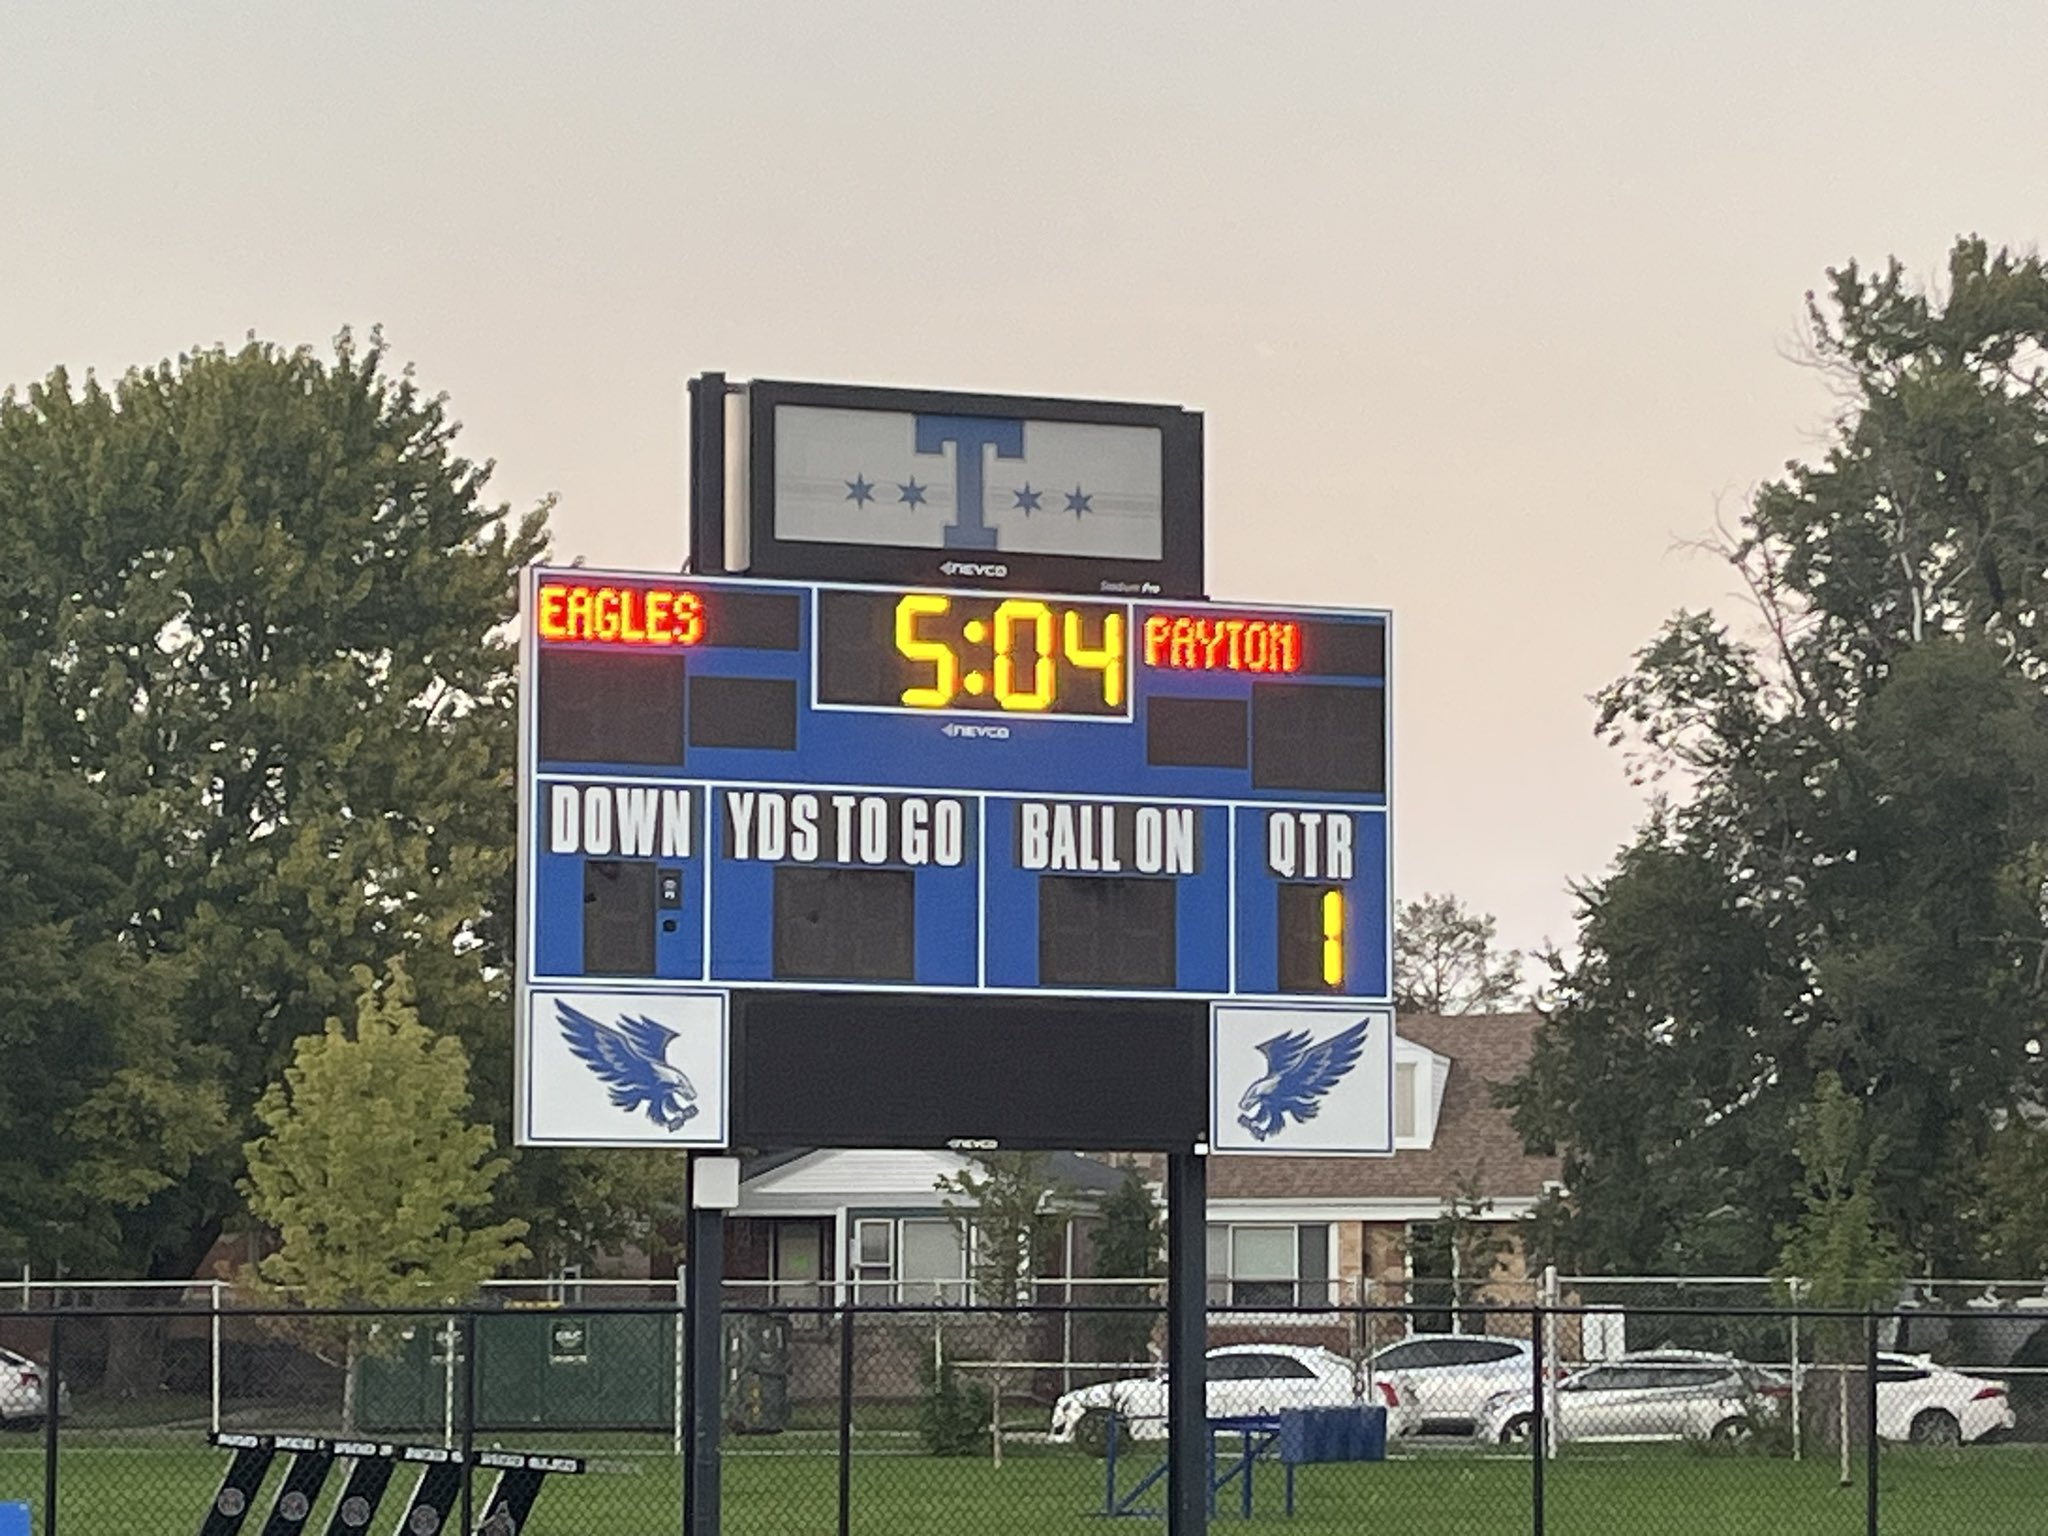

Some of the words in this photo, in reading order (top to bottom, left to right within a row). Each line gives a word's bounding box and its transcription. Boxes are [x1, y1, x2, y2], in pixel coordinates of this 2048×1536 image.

[916, 414, 1024, 550] T
[539, 584, 704, 646] EAGLES
[1144, 615, 1300, 673] PAYTON
[895, 594, 1124, 712] 5:04
[551, 785, 691, 858] DOWN
[727, 791, 820, 863] YDS
[832, 795, 889, 864] TO
[901, 797, 963, 867] GO
[1021, 802, 1121, 873] BALL
[1135, 807, 1194, 874] ON
[1269, 812, 1353, 879] QTR
[1323, 890, 1343, 986] 1
